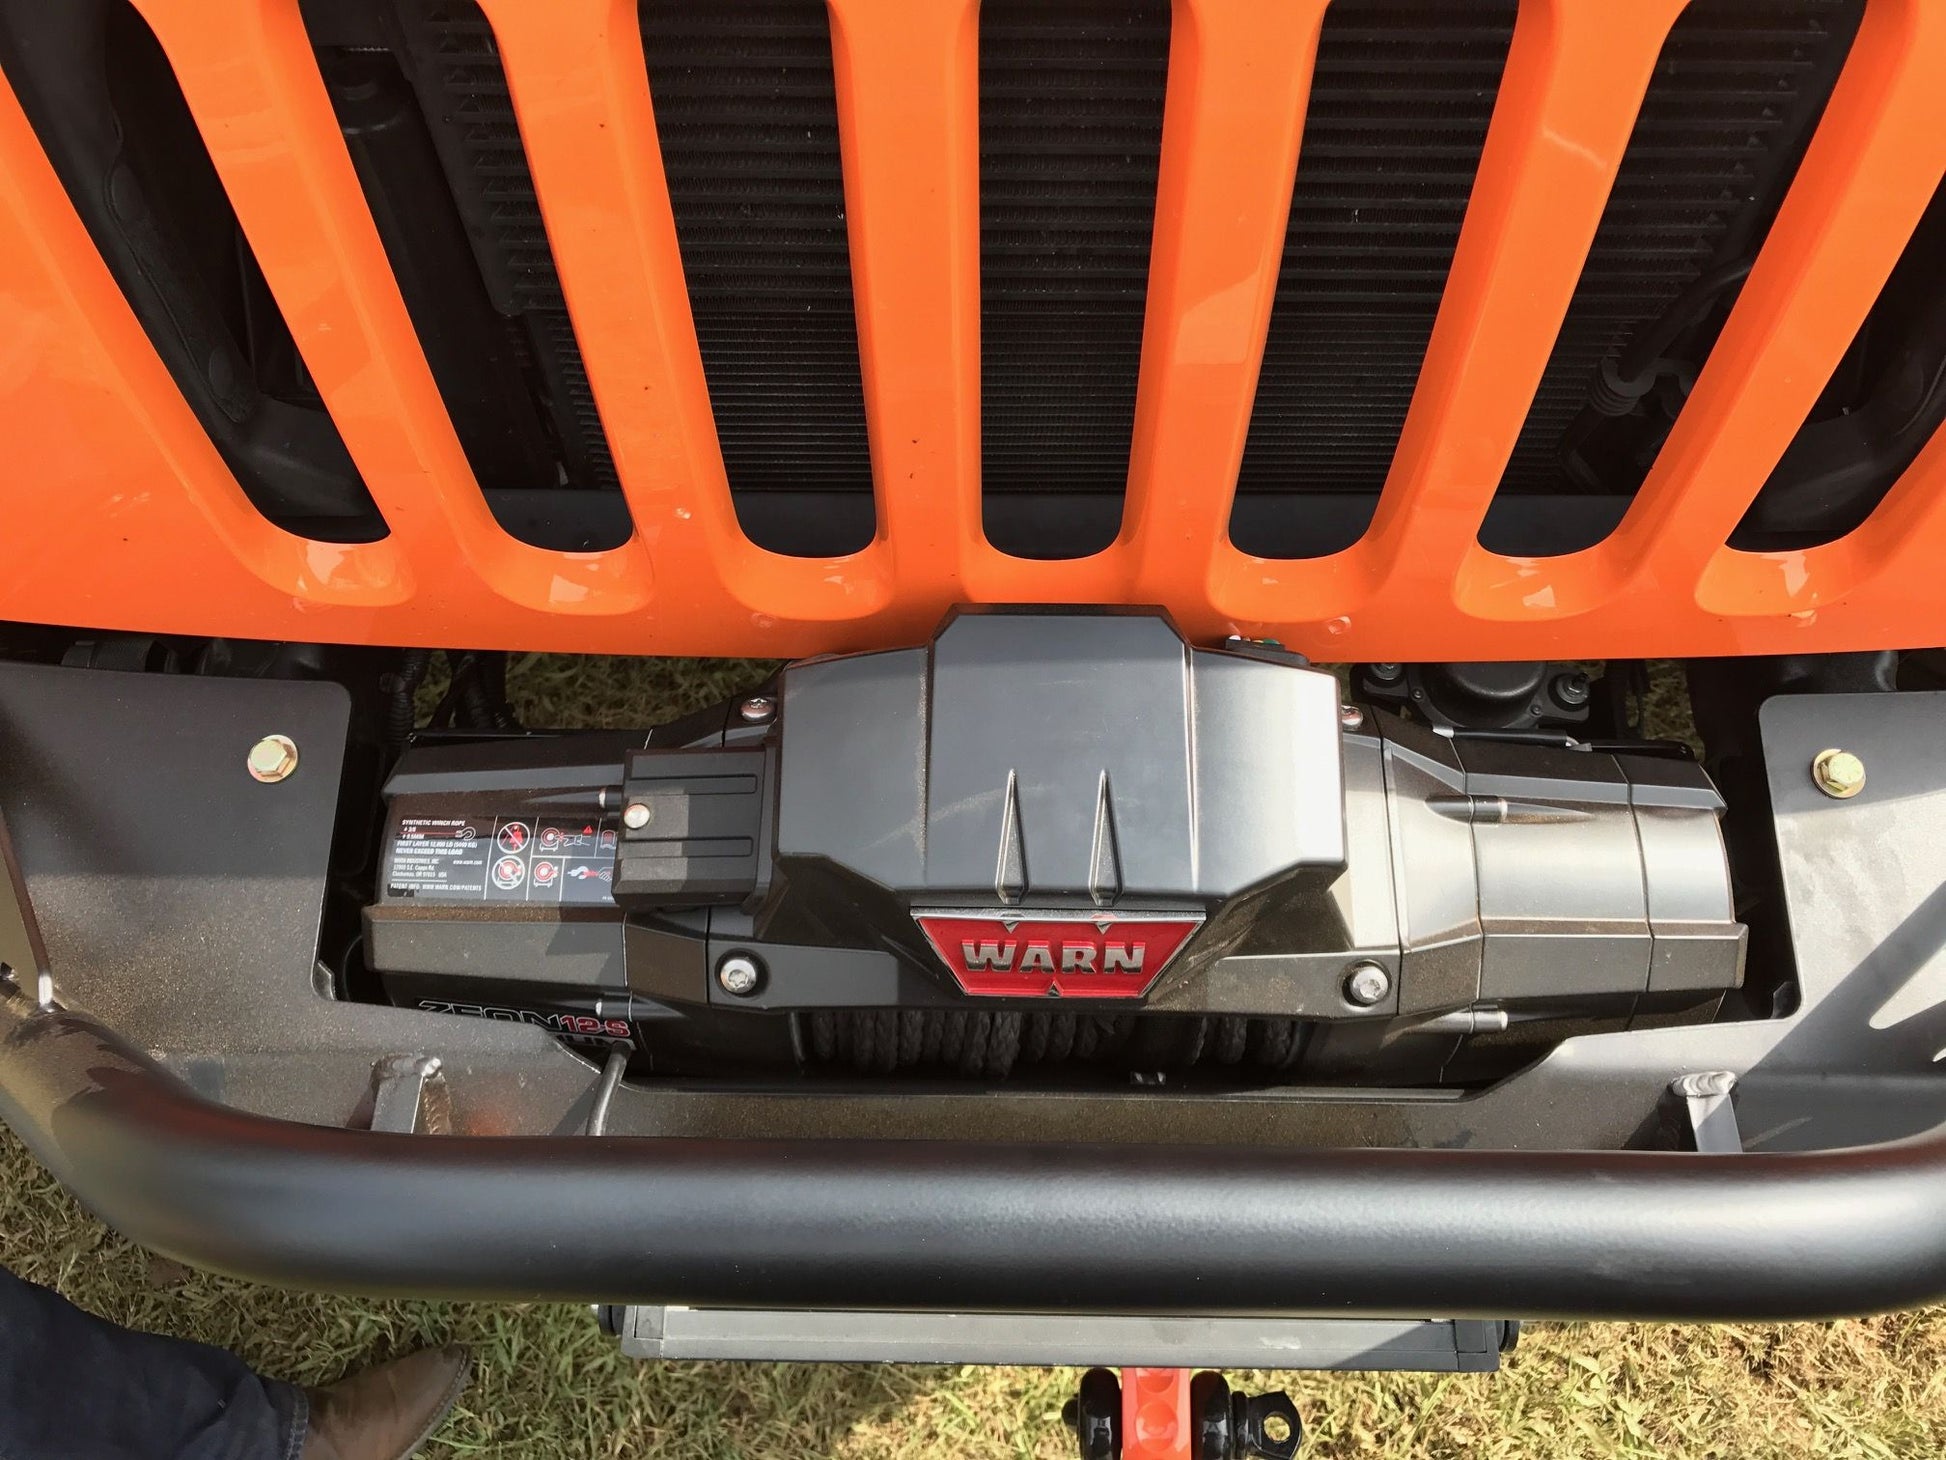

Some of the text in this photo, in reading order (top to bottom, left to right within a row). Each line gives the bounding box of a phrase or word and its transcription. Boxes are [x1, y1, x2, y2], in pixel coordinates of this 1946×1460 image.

[414, 847, 435, 855] EXCEED
[390, 882, 408, 890] PATENT
[961, 939, 1146, 975] WARN
